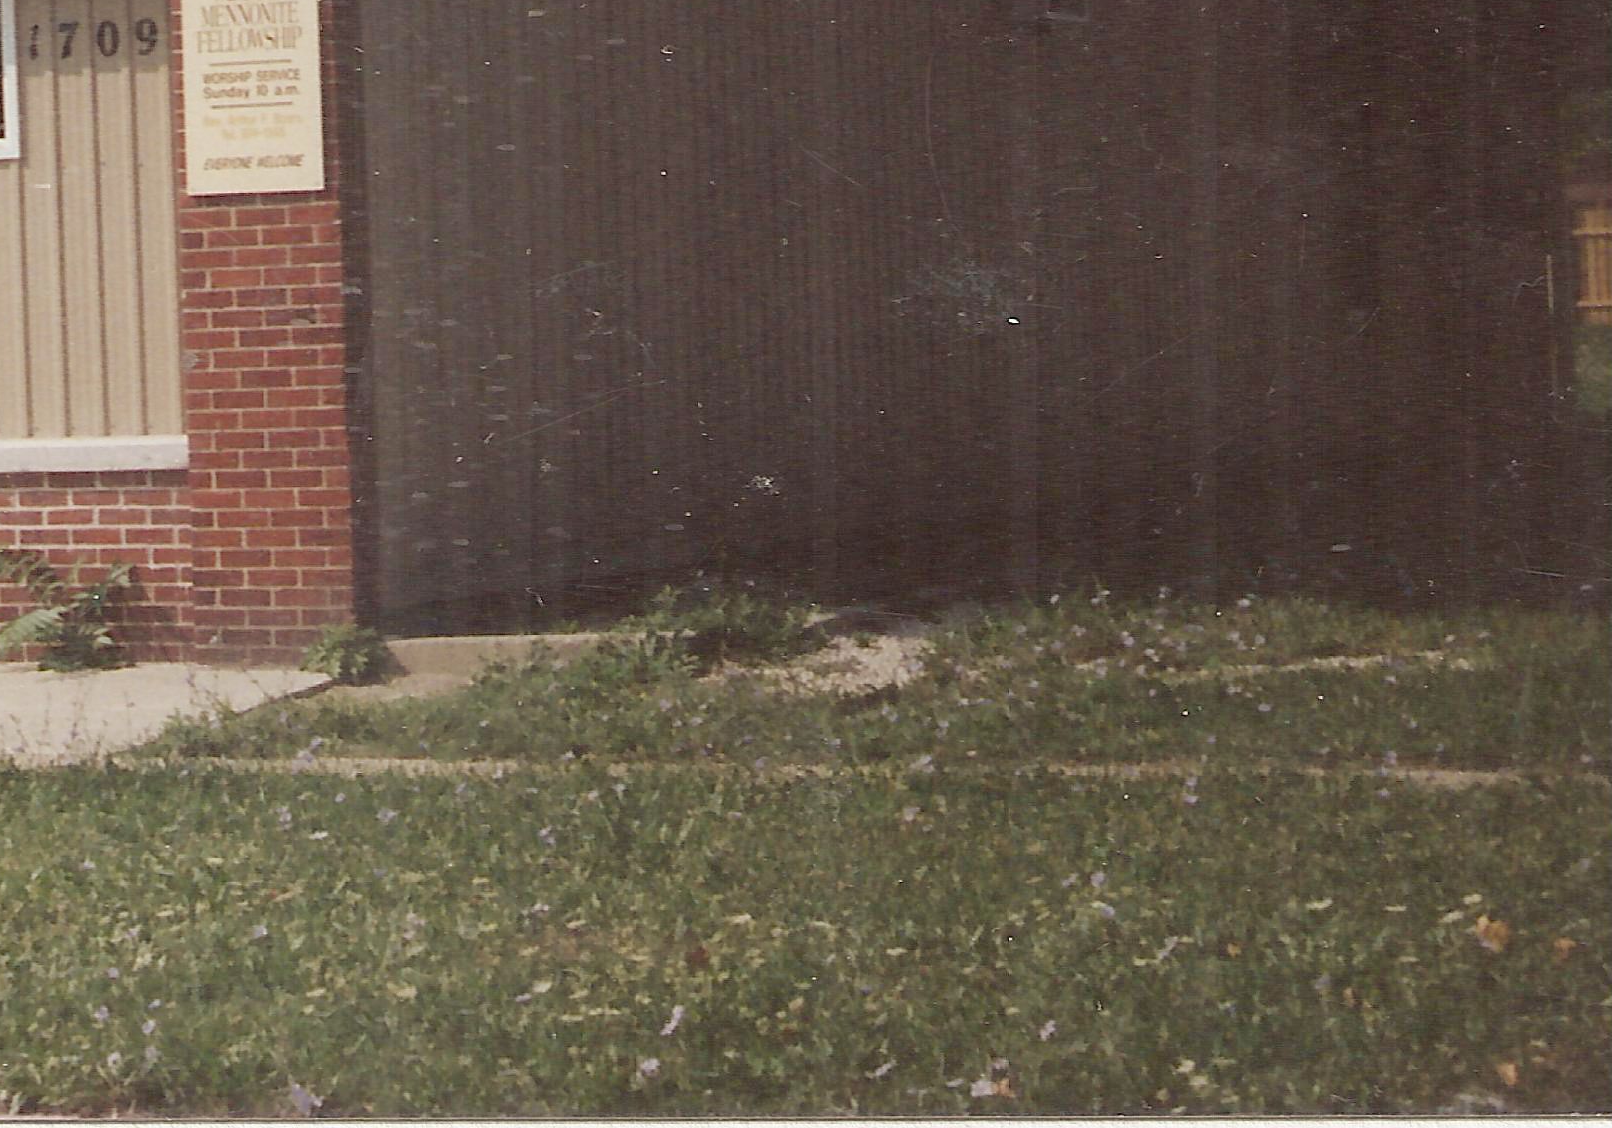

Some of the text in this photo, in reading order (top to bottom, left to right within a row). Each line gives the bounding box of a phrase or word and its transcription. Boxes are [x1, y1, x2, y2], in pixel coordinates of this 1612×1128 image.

[200, 2, 299, 27] MENNONITE
[29, 18, 158, 60] 1709
[197, 27, 303, 54] FELLOWSHIP
[203, 68, 301, 85] WORSHIP SERVICE
[203, 85, 250, 100] Sunday
[256, 83, 269, 97] 10
